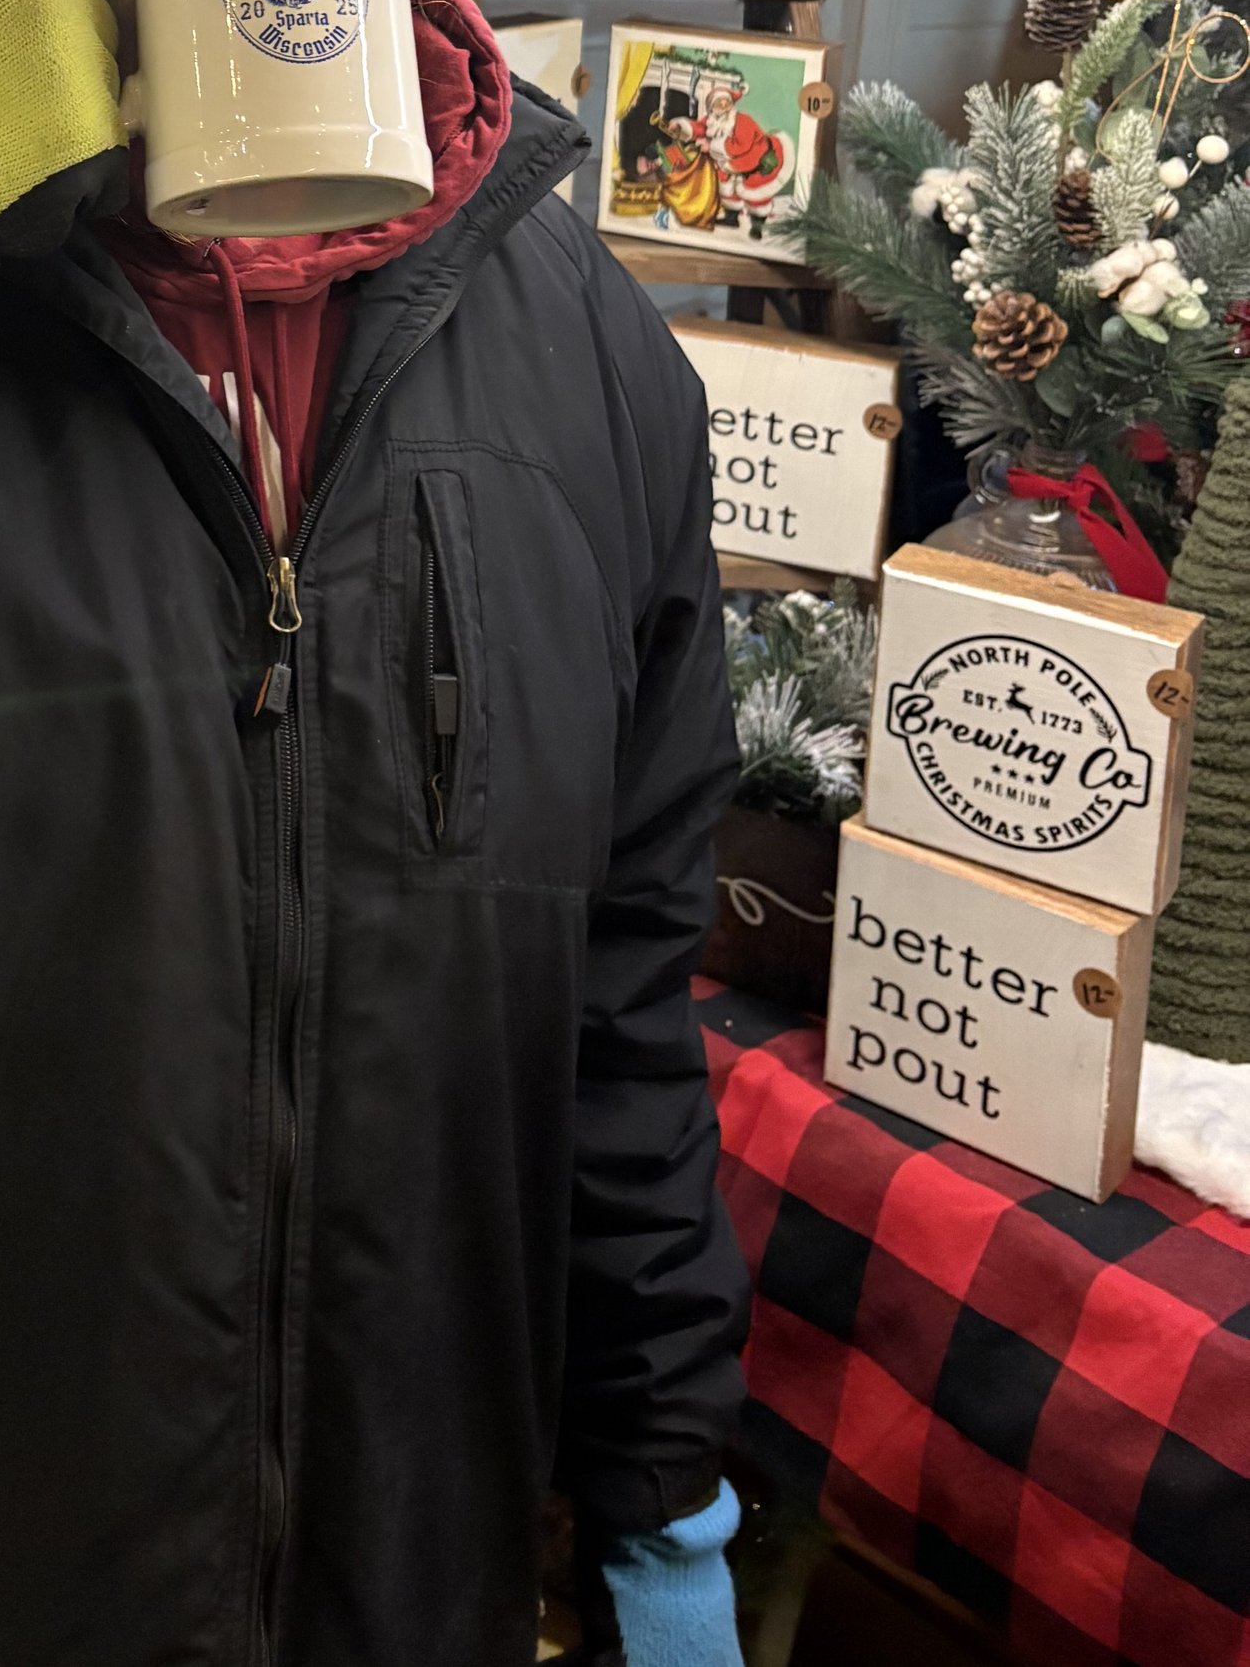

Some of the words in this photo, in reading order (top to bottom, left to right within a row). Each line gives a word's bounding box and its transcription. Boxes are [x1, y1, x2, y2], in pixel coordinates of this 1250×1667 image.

[240, 0, 265, 21] 20
[258, 24, 349, 57] Wisconsin
[276, 10, 329, 31] Sparta
[948, 646, 1030, 673] NORTH
[1039, 658, 1097, 708] POLE
[895, 693, 1067, 786] Brewing
[1078, 747, 1142, 790] Co
[962, 689, 1003, 714] EST.
[1040, 710, 1084, 735] 1773
[916, 741, 1026, 843] CHRISTMAS
[1034, 792, 1113, 845] SPIRITS
[972, 776, 1052, 810] PREMIUM
[847, 894, 1059, 1018] better
[869, 975, 979, 1050] not
[846, 1024, 1002, 1120] pout
